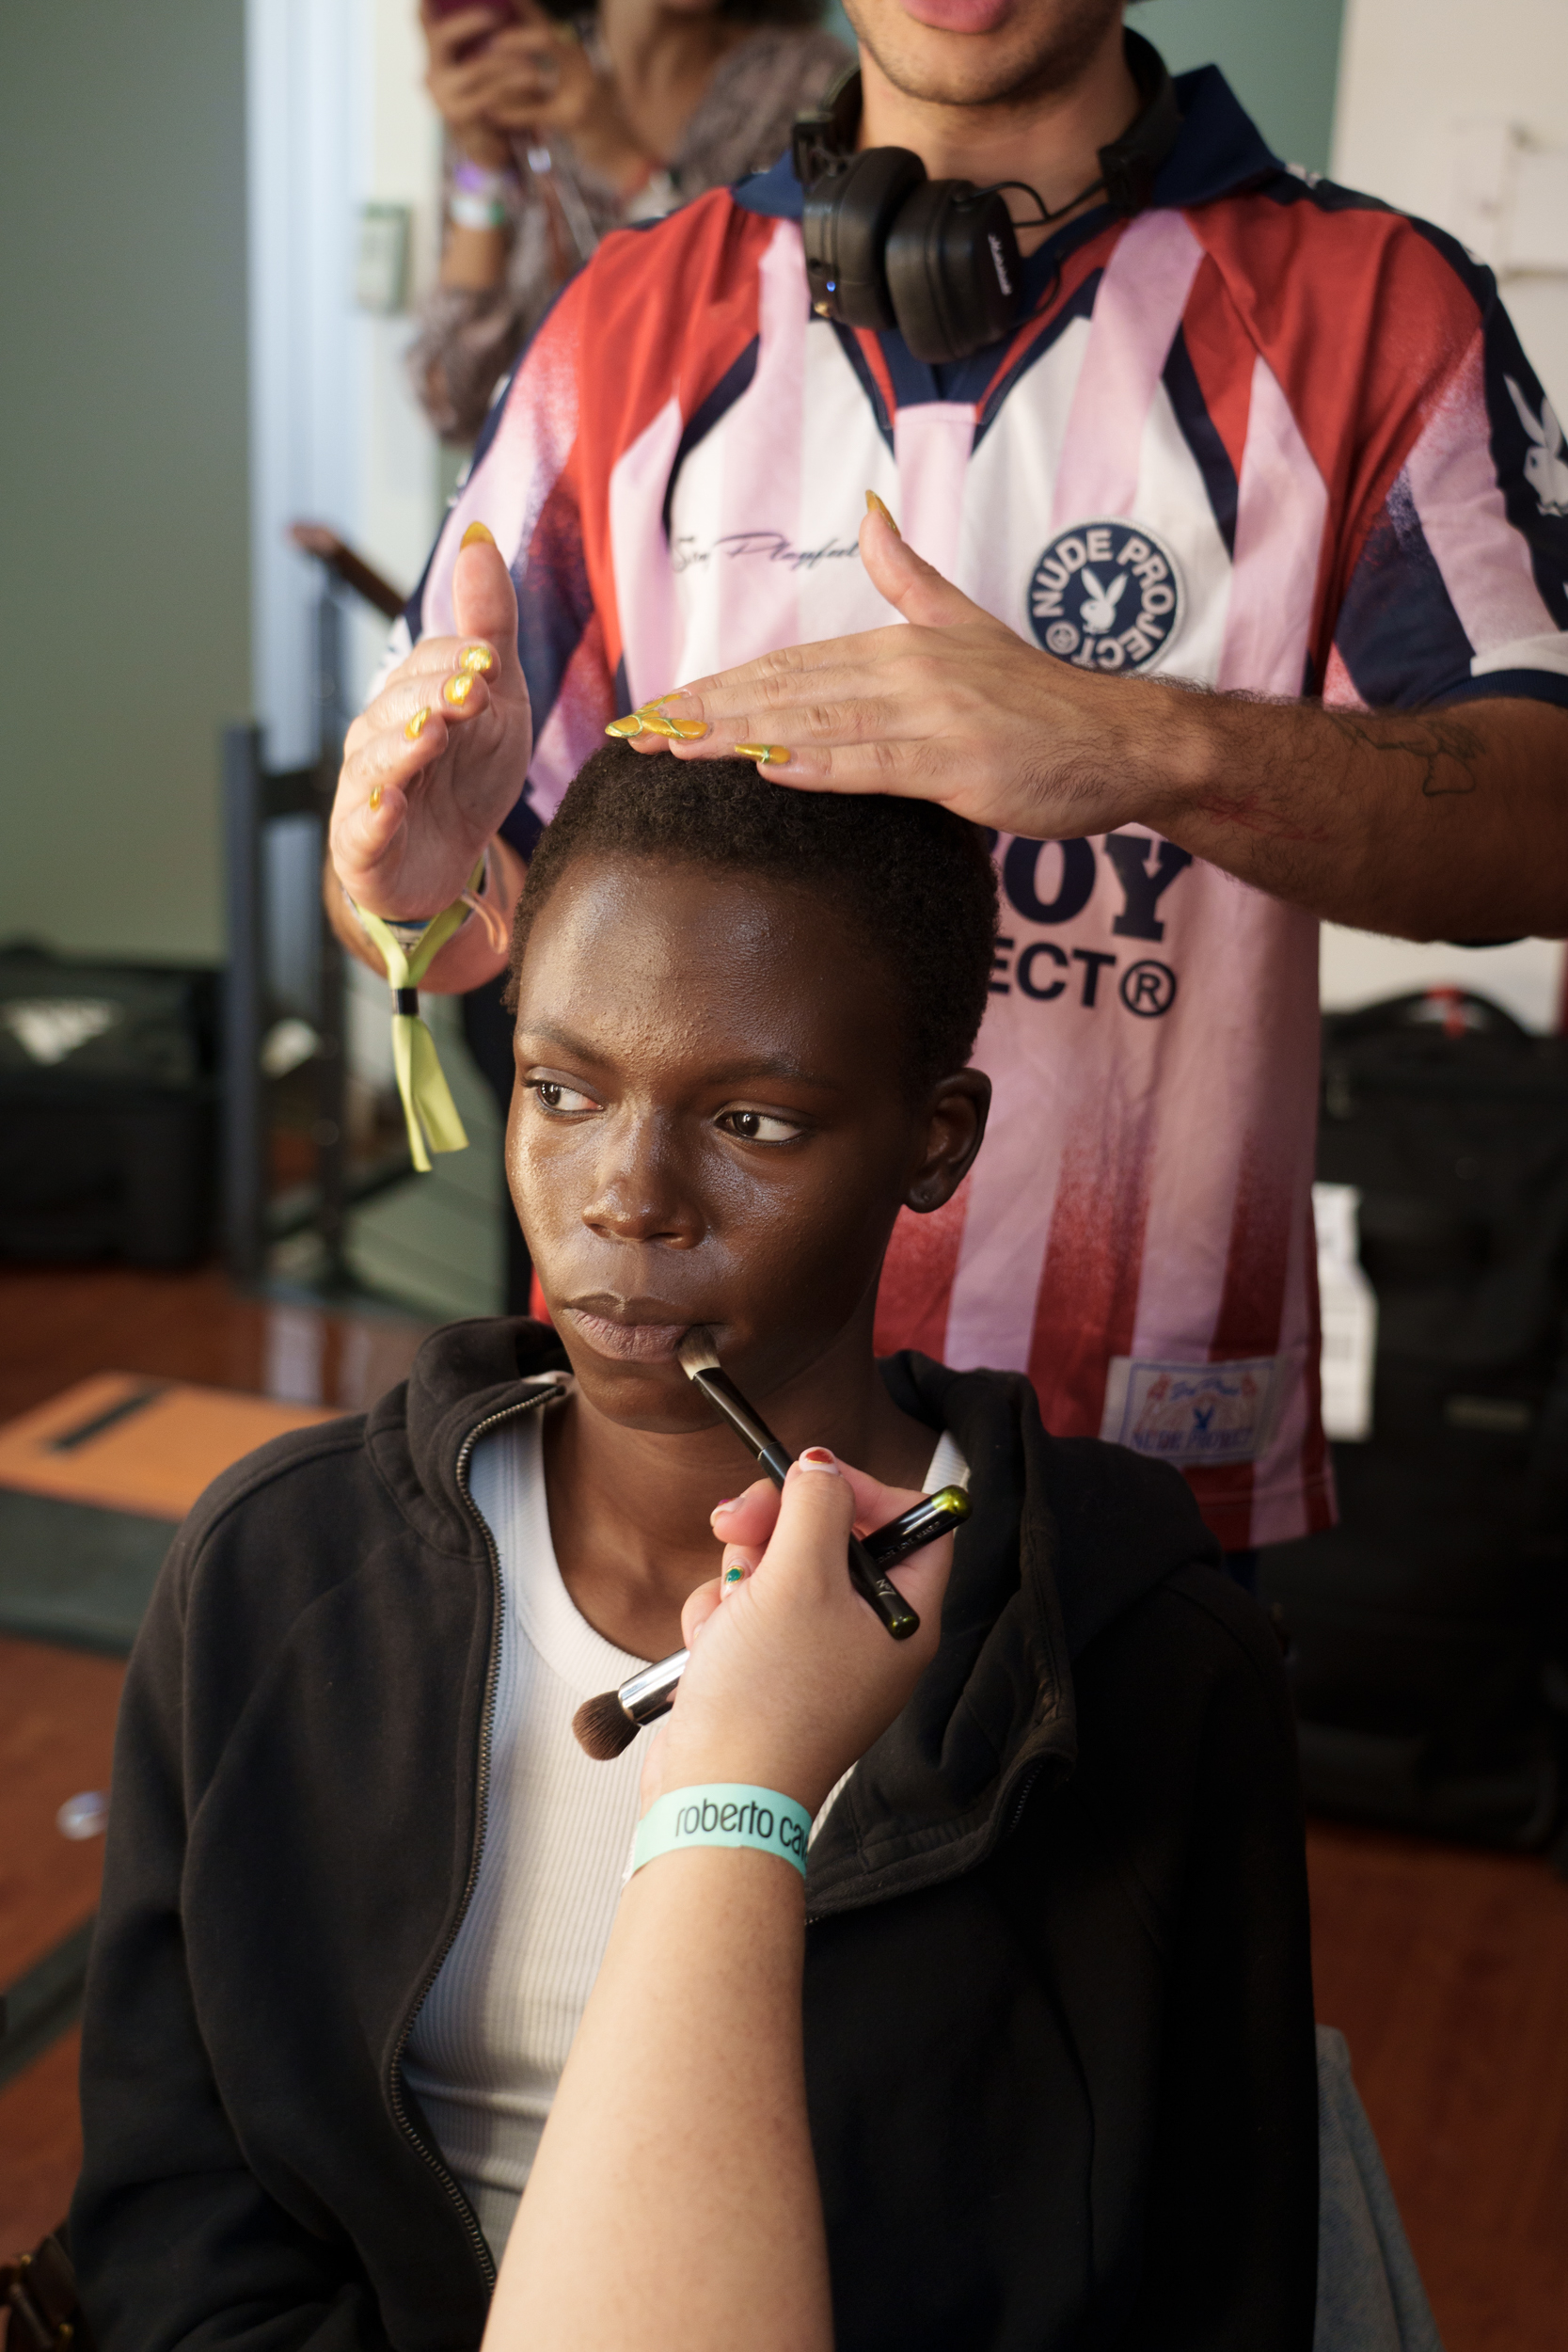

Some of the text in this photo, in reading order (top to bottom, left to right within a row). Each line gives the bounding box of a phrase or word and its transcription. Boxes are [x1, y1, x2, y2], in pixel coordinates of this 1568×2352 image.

[1033, 529, 1114, 618] NUDE
[987, 826, 1194, 942] OY
[674, 1798, 809, 1867] roberto cav
